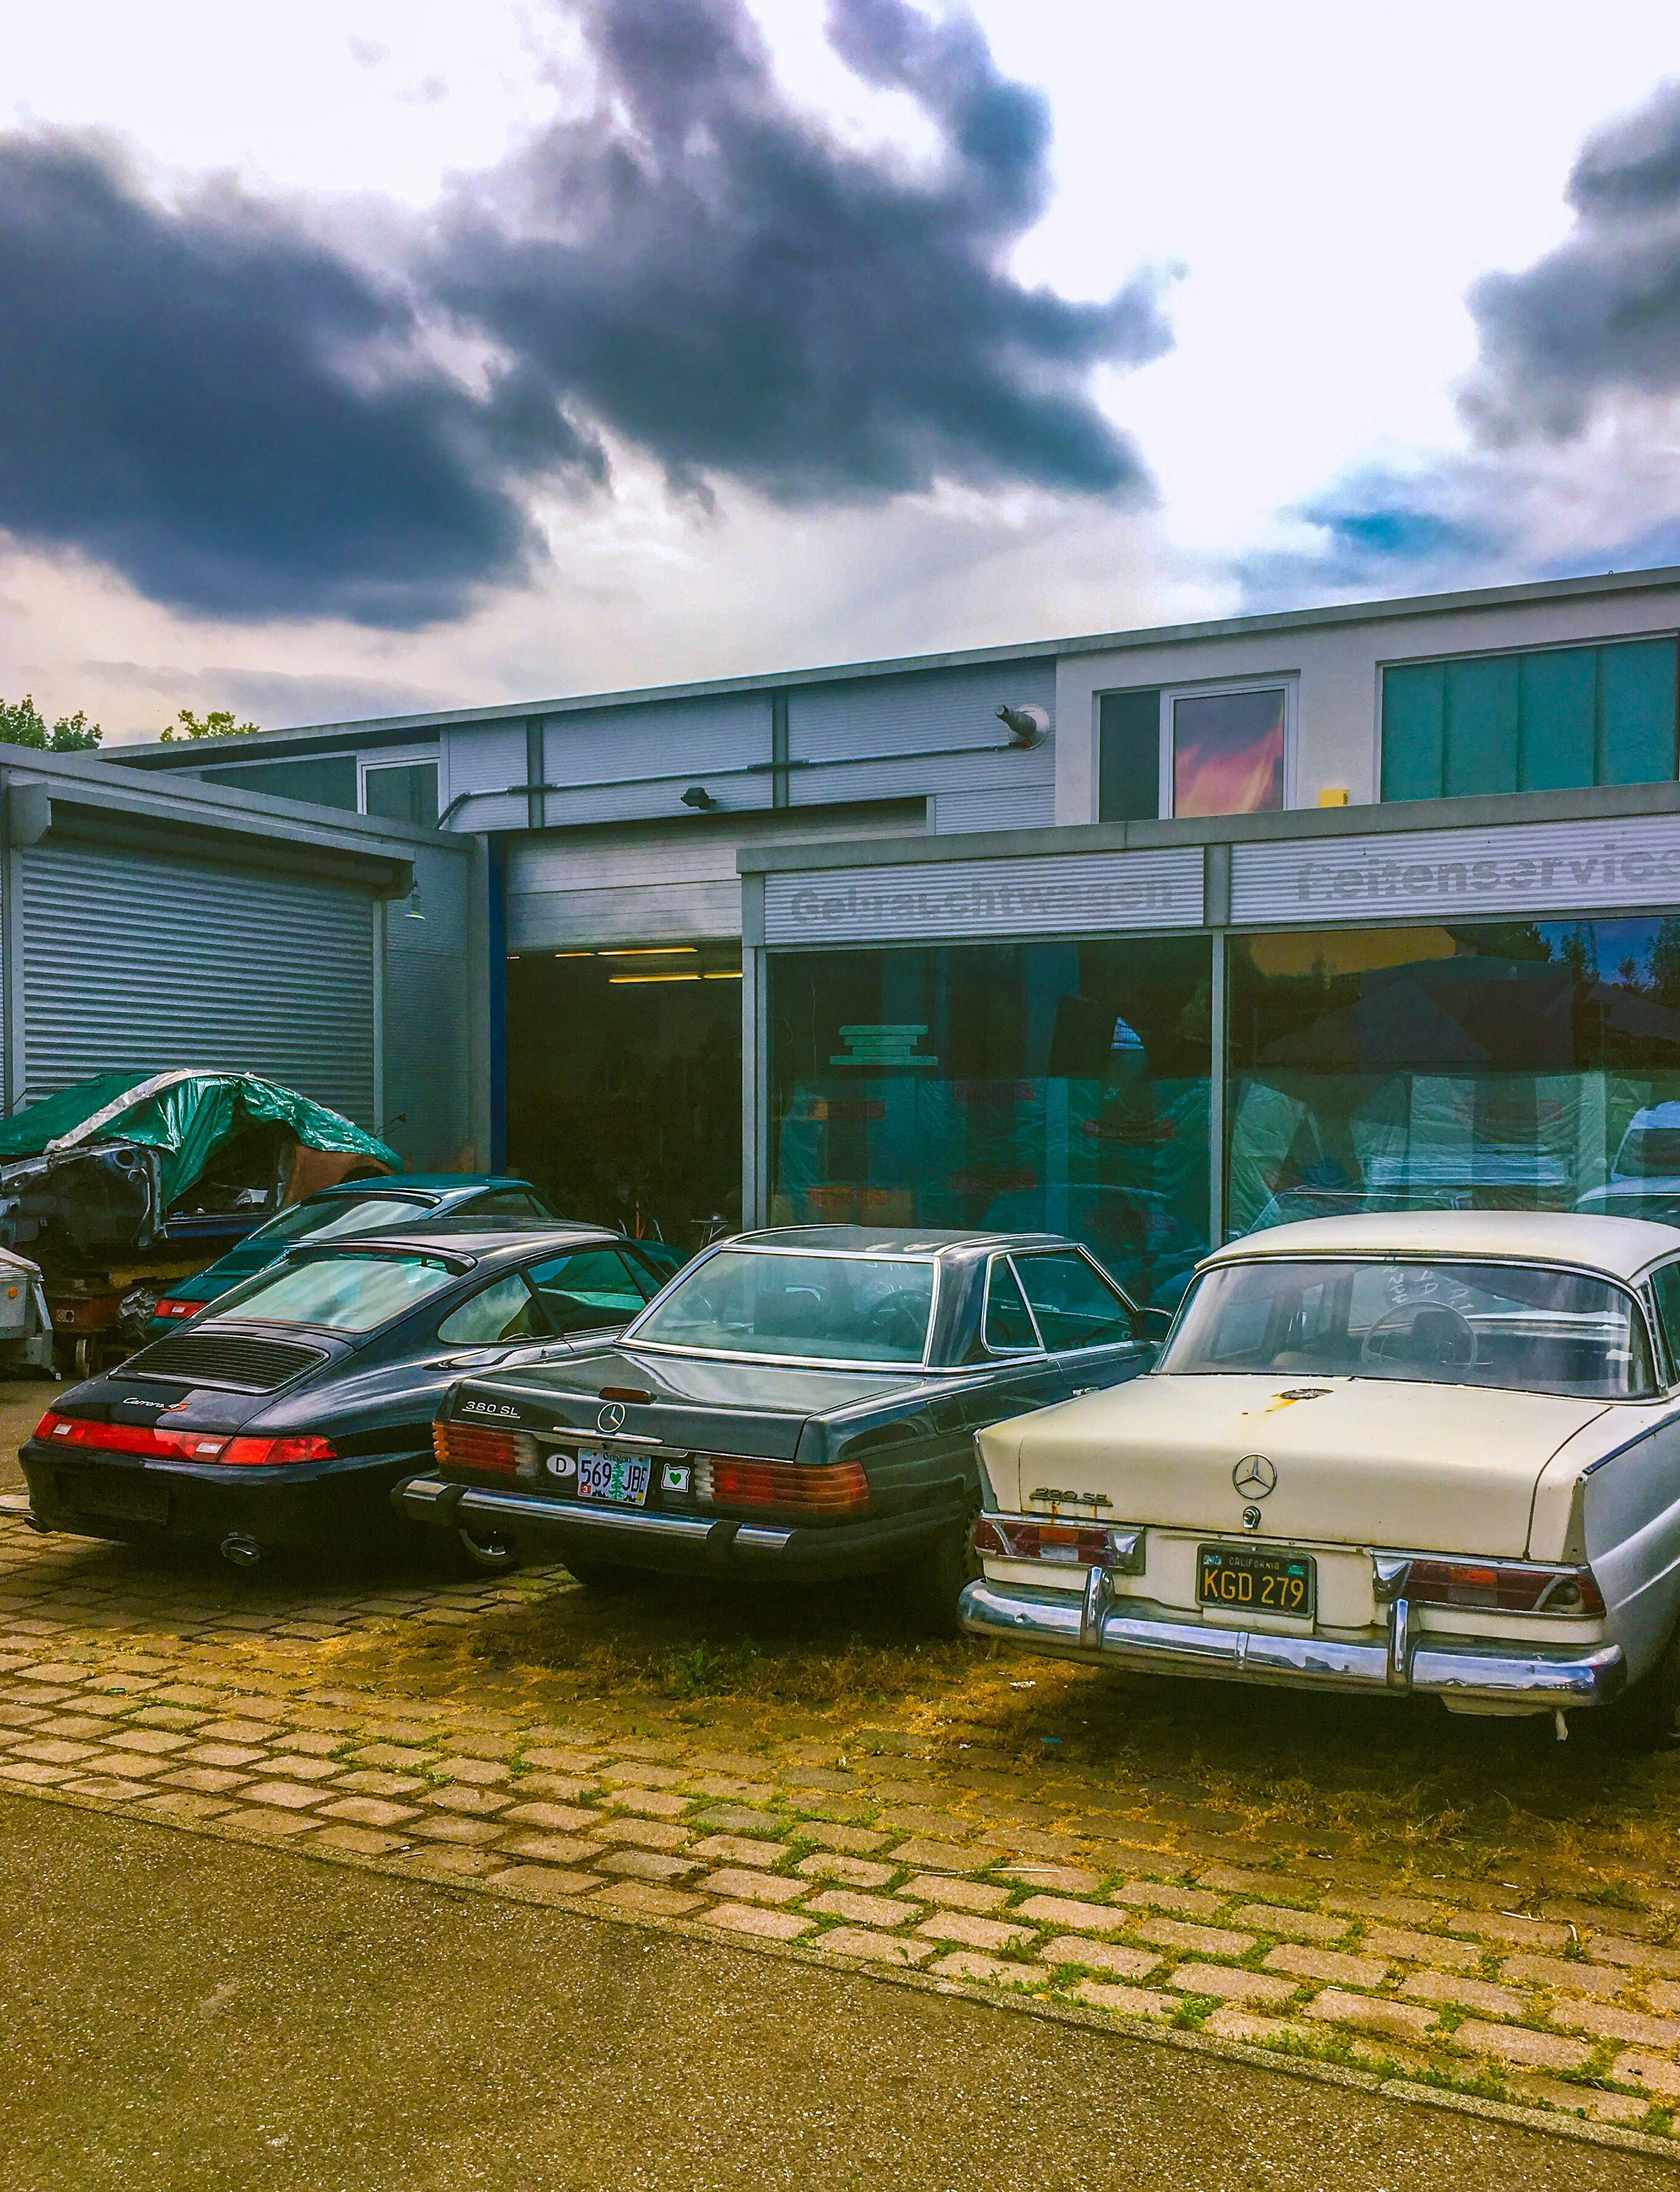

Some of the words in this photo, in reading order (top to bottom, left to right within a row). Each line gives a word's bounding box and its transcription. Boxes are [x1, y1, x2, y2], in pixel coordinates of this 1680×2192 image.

[465, 1401, 497, 1413] 380
[500, 1405, 518, 1416] SL
[556, 1457, 567, 1473] D
[602, 1452, 632, 1464] Oregon
[581, 1459, 612, 1488] 569
[1229, 1556, 1280, 1571] CALIFORNIA
[1204, 1568, 1253, 1601] KGD
[1262, 1575, 1304, 1607] 279
